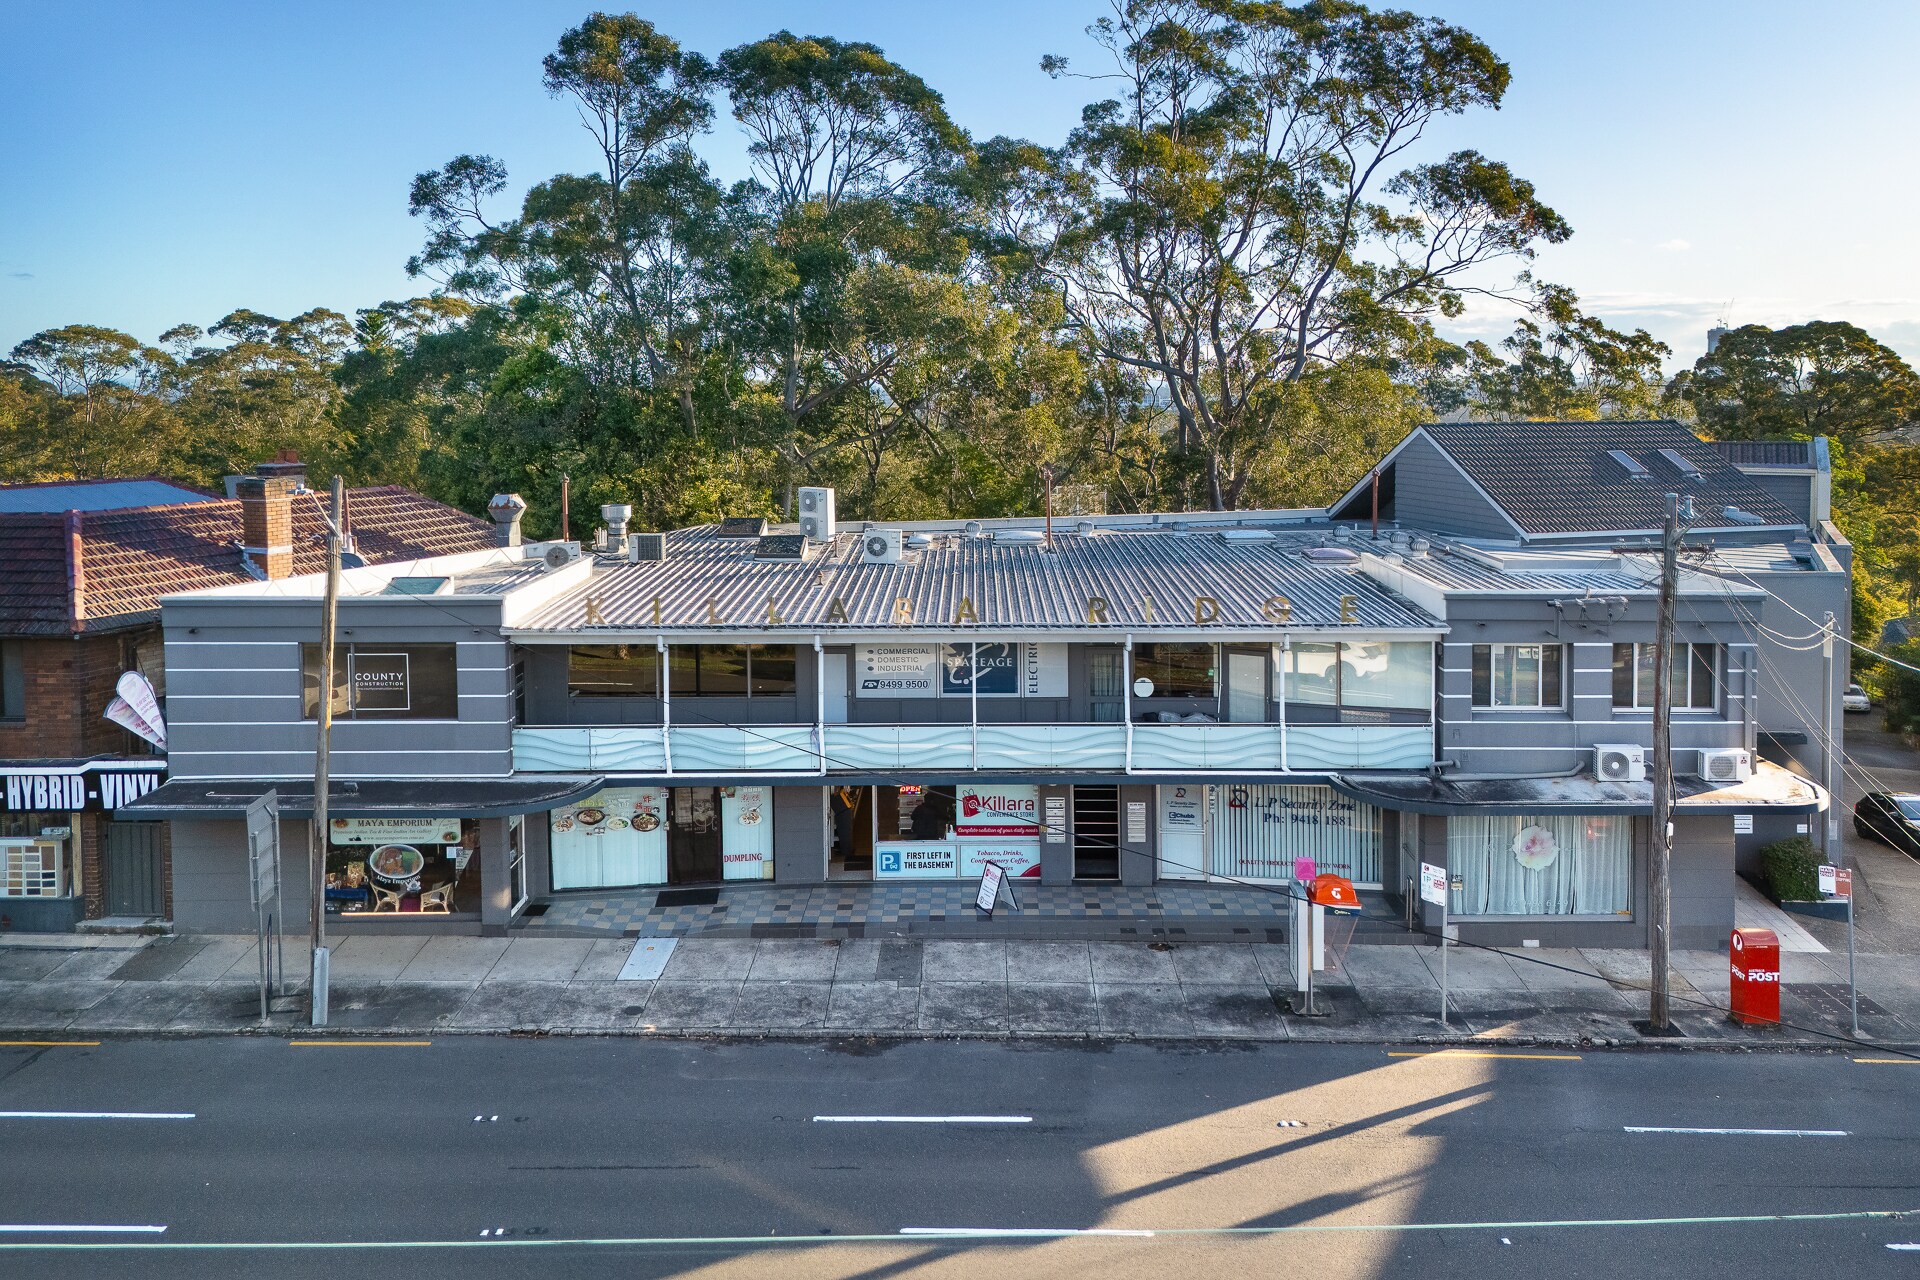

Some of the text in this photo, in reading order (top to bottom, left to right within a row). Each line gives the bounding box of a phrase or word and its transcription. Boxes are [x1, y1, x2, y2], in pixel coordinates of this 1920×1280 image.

[586, 594, 1358, 625] KILLARA RIDGE
[355, 672, 404, 681] COUNTY
[880, 680, 929, 689] 9499 9500
[7, 775, 85, 810] HYBRID
[982, 796, 1035, 811] Killara
[1280, 797, 1325, 812] Security
[1328, 800, 1357, 811] Zone
[357, 819, 384, 827] MAYA
[387, 819, 433, 827] EMPORIUM
[1263, 812, 1352, 827] Ph: 9418 1881
[723, 853, 763, 863] DUMPLING
[906, 851, 951, 859] FIRST LEFT IN
[904, 861, 954, 869] THE BASEMENT
[1010, 857, 1030, 865] Coffee,
[1731, 966, 1745, 981] POST
[1748, 972, 1780, 982] POST
